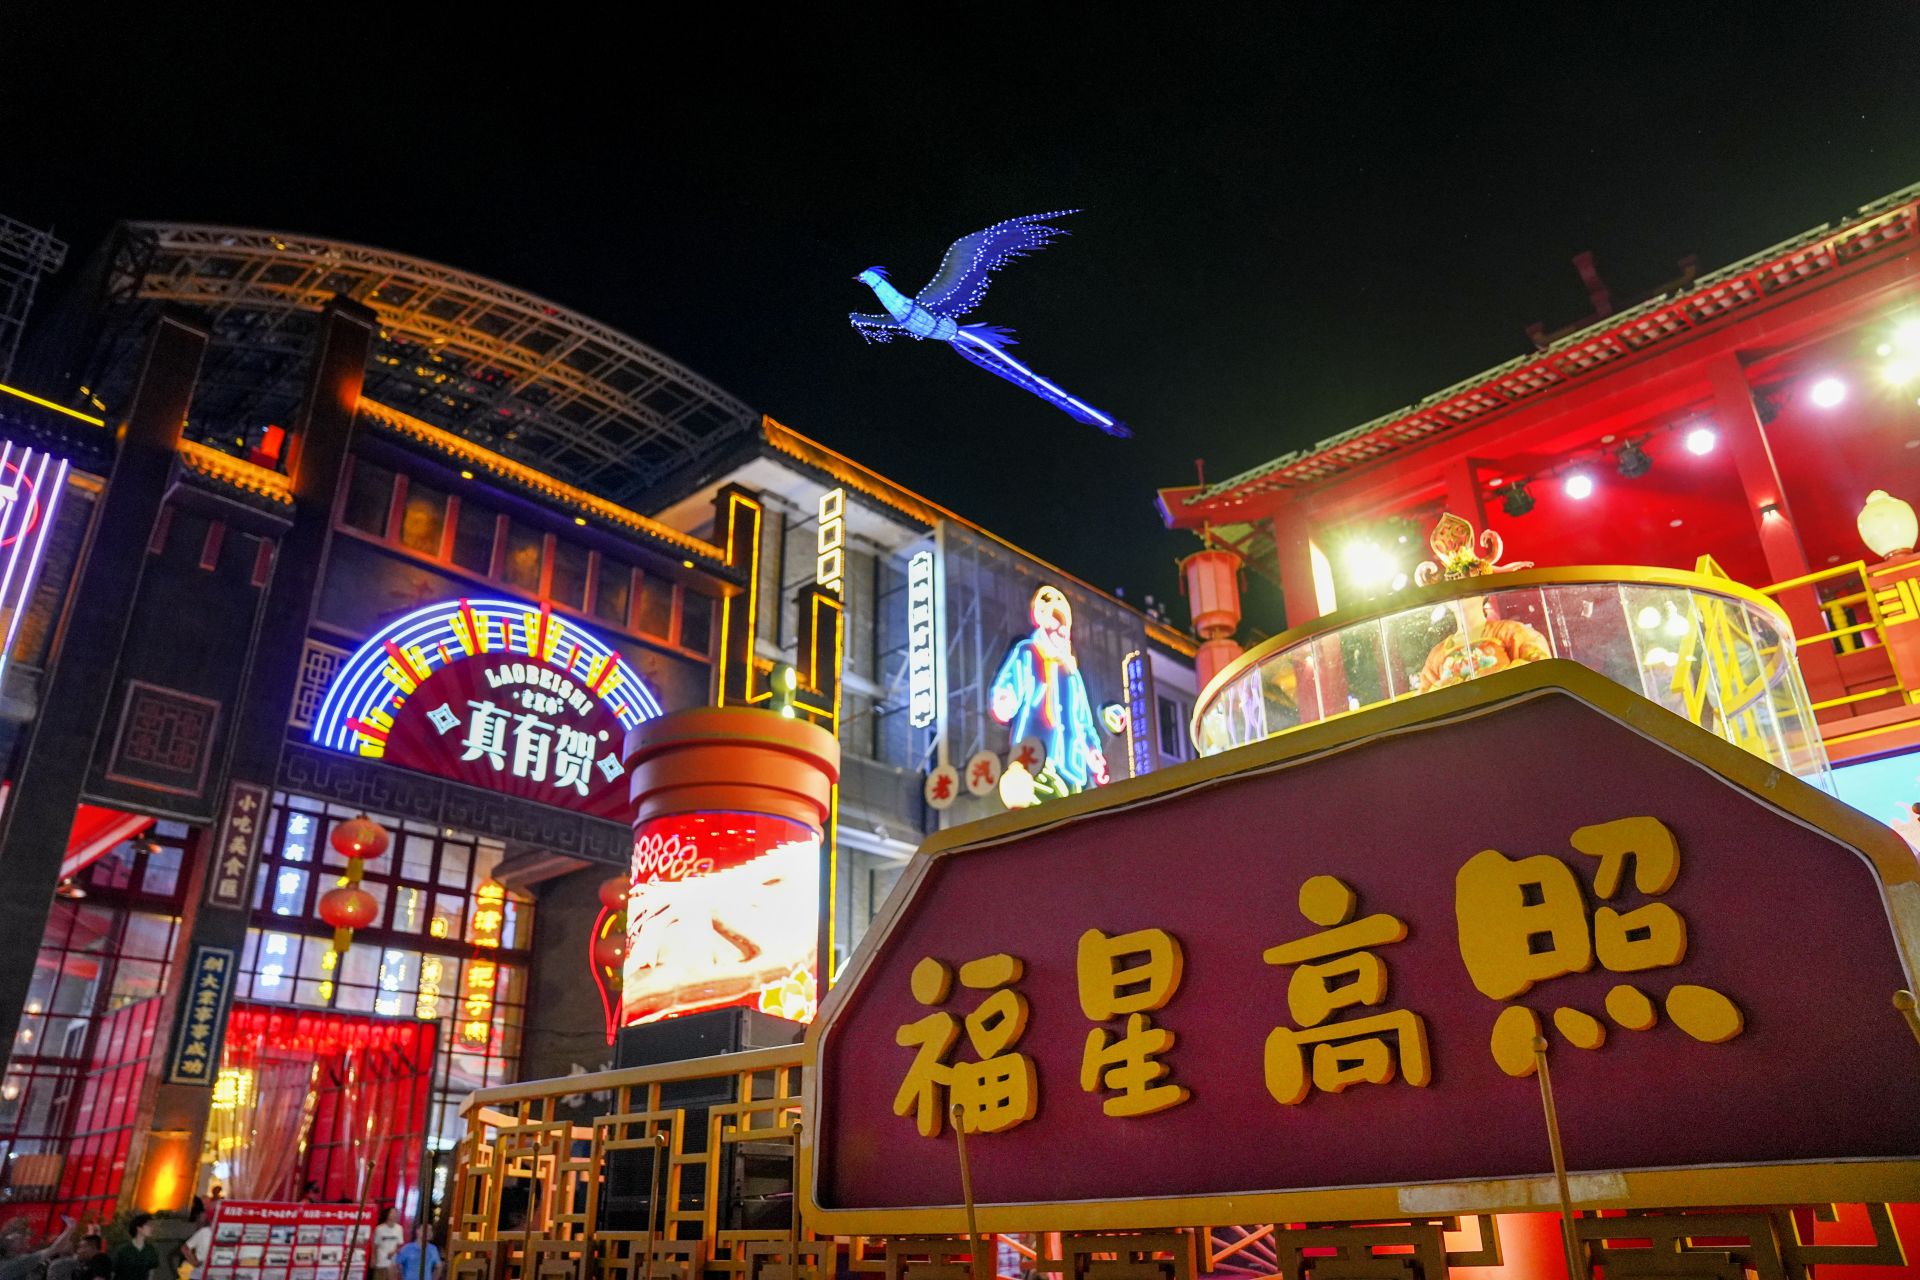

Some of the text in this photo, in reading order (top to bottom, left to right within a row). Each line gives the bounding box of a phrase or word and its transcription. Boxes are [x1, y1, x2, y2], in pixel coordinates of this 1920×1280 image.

[485, 663, 594, 717] LAOBEISHI
[461, 700, 597, 797] 真有贺
[893, 815, 1745, 1138] 福星高照
